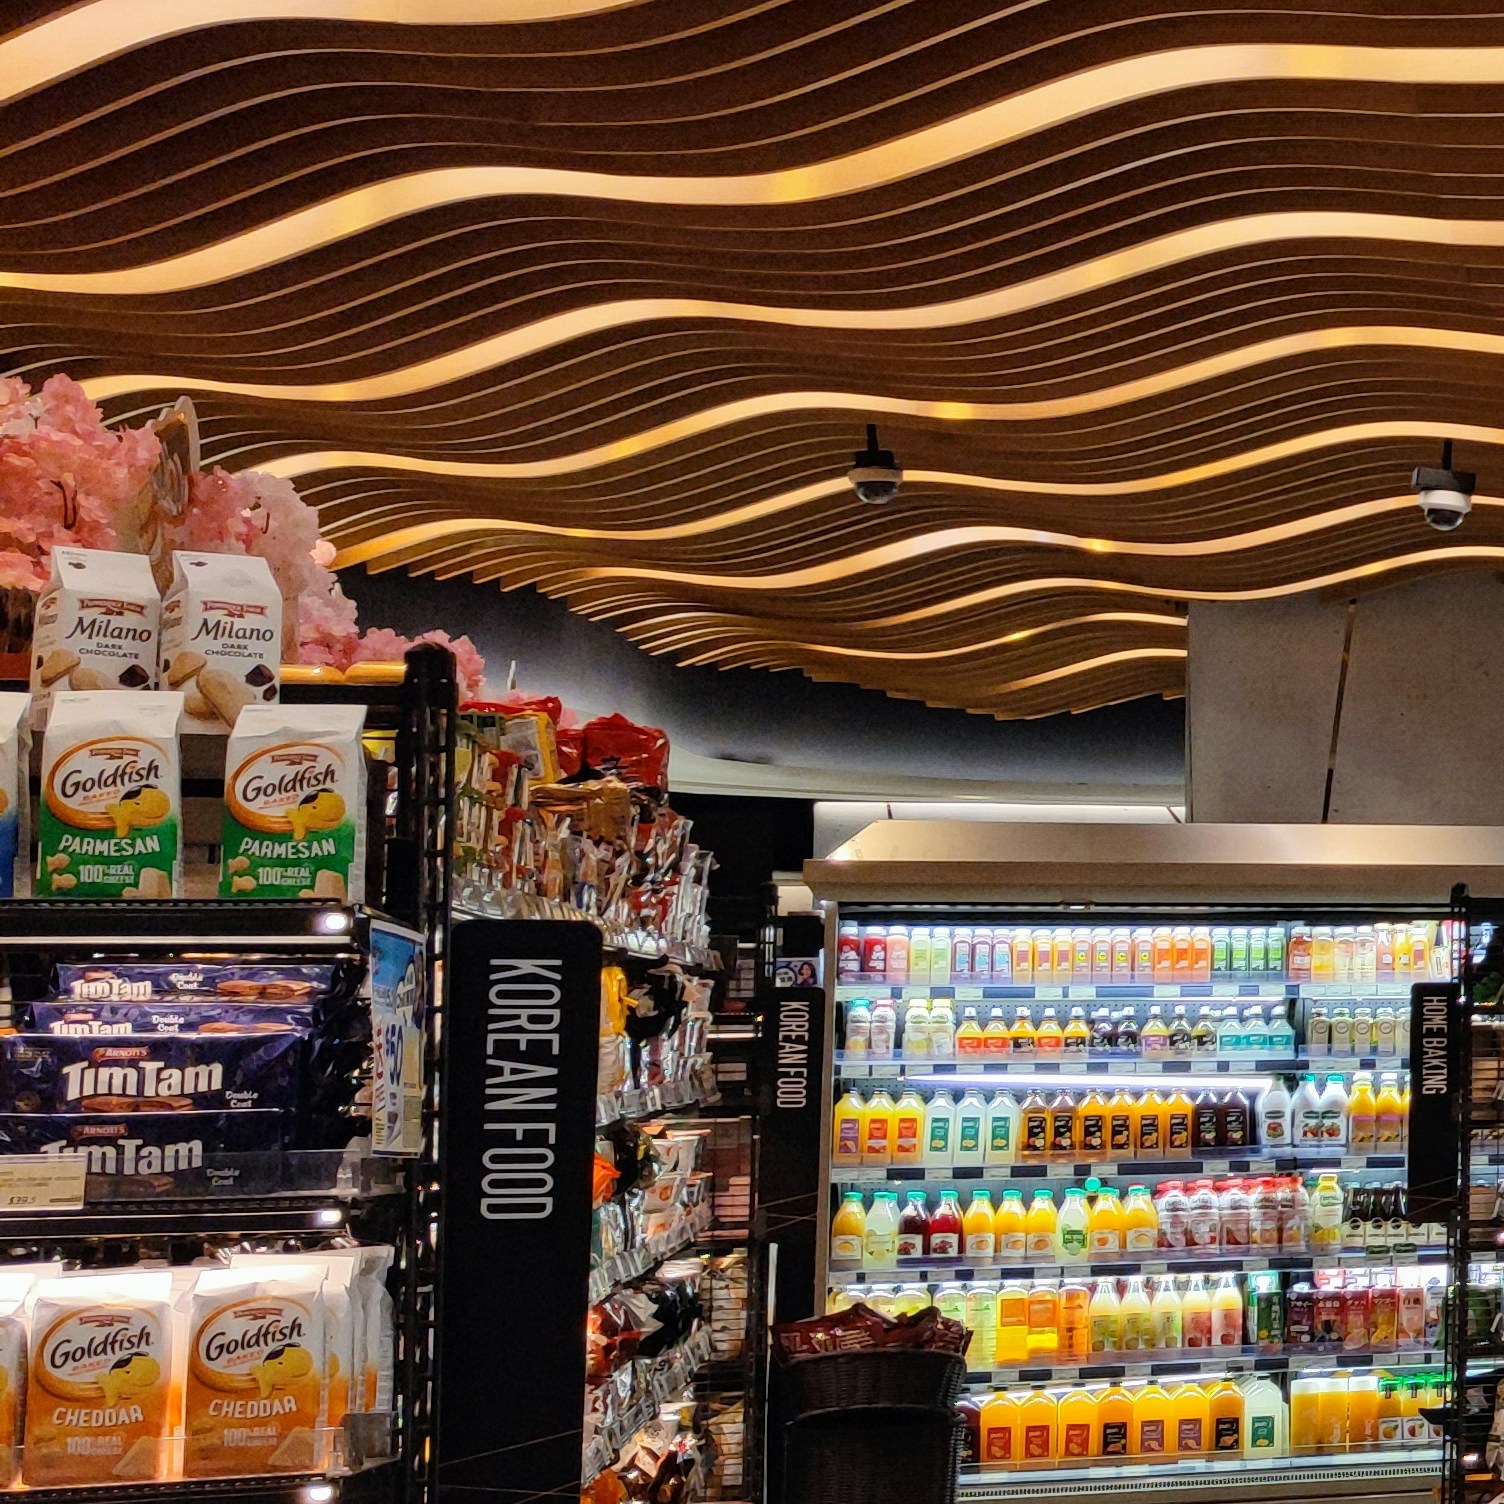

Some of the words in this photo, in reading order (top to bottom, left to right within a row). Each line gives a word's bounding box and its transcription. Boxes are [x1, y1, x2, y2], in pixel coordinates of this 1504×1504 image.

[66, 617, 151, 642] Milano
[191, 618, 274, 642] Milano
[79, 648, 139, 660] CHOCOLATE
[96, 642, 123, 650] DARK
[205, 649, 264, 659] CHOCOLATE
[61, 758, 160, 798] Goldfish
[242, 763, 337, 803] Goldfish
[58, 834, 160, 856] PARMESAN
[239, 838, 336, 858] PARMESAN
[152, 1015, 184, 1025] Double
[1421, 996, 1447, 1031] HOME
[485, 958, 562, 1111] KOREAN
[780, 1001, 810, 1065] KOREAN
[1422, 1035, 1449, 1095] BAKING
[225, 1091, 258, 1100] Double
[776, 1068, 807, 1109] FOOD
[479, 1124, 556, 1220] FOOD
[50, 1325, 150, 1369] Goldfish
[206, 1316, 303, 1360] Goldfish
[53, 1405, 143, 1427] CHEDDAR
[208, 1396, 296, 1418] CHEDDAR
